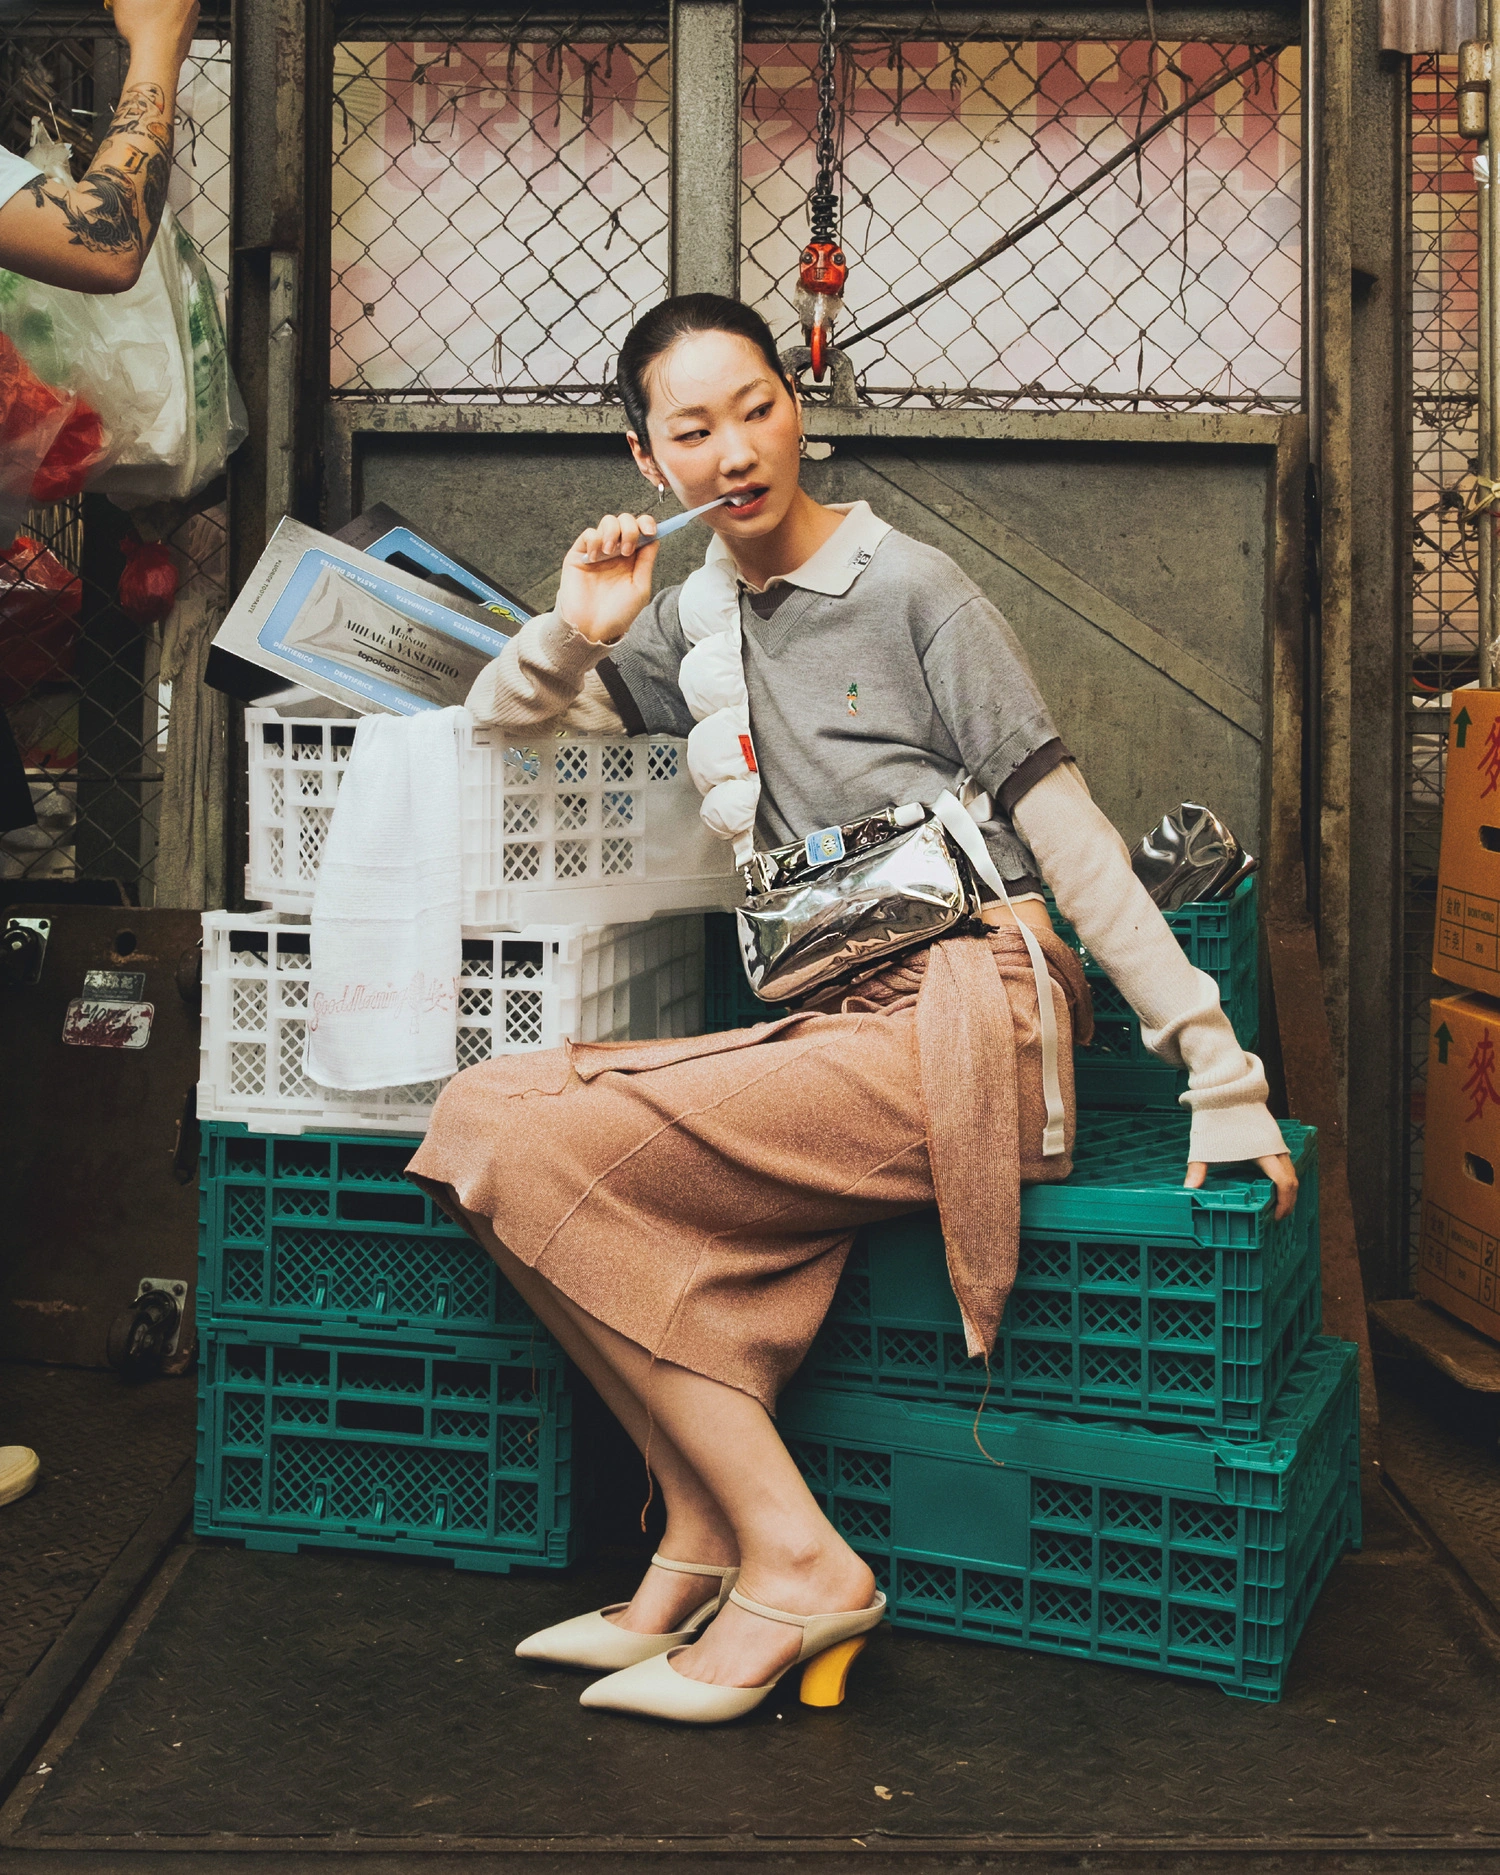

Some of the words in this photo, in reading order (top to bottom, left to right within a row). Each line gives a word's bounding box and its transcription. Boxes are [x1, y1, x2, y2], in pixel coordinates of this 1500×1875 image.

[265, 559, 282, 584] FLUORIDE
[319, 558, 343, 574] DENTES
[343, 569, 356, 580] DE
[355, 575, 378, 591] PASTA
[248, 582, 269, 615] TOOTHPASTE
[395, 592, 435, 617] ZAHNPASTA
[388, 623, 429, 651] Maison
[452, 620, 481, 638] DIENTES
[481, 634, 491, 642] DE
[344, 617, 394, 650] MIHARA
[394, 640, 460, 682] YASUHIRO
[491, 638, 504, 648] STA
[356, 648, 401, 677] topologie
[334, 668, 374, 693] DENTIFRICE
[393, 696, 425, 716] TOOTHP
